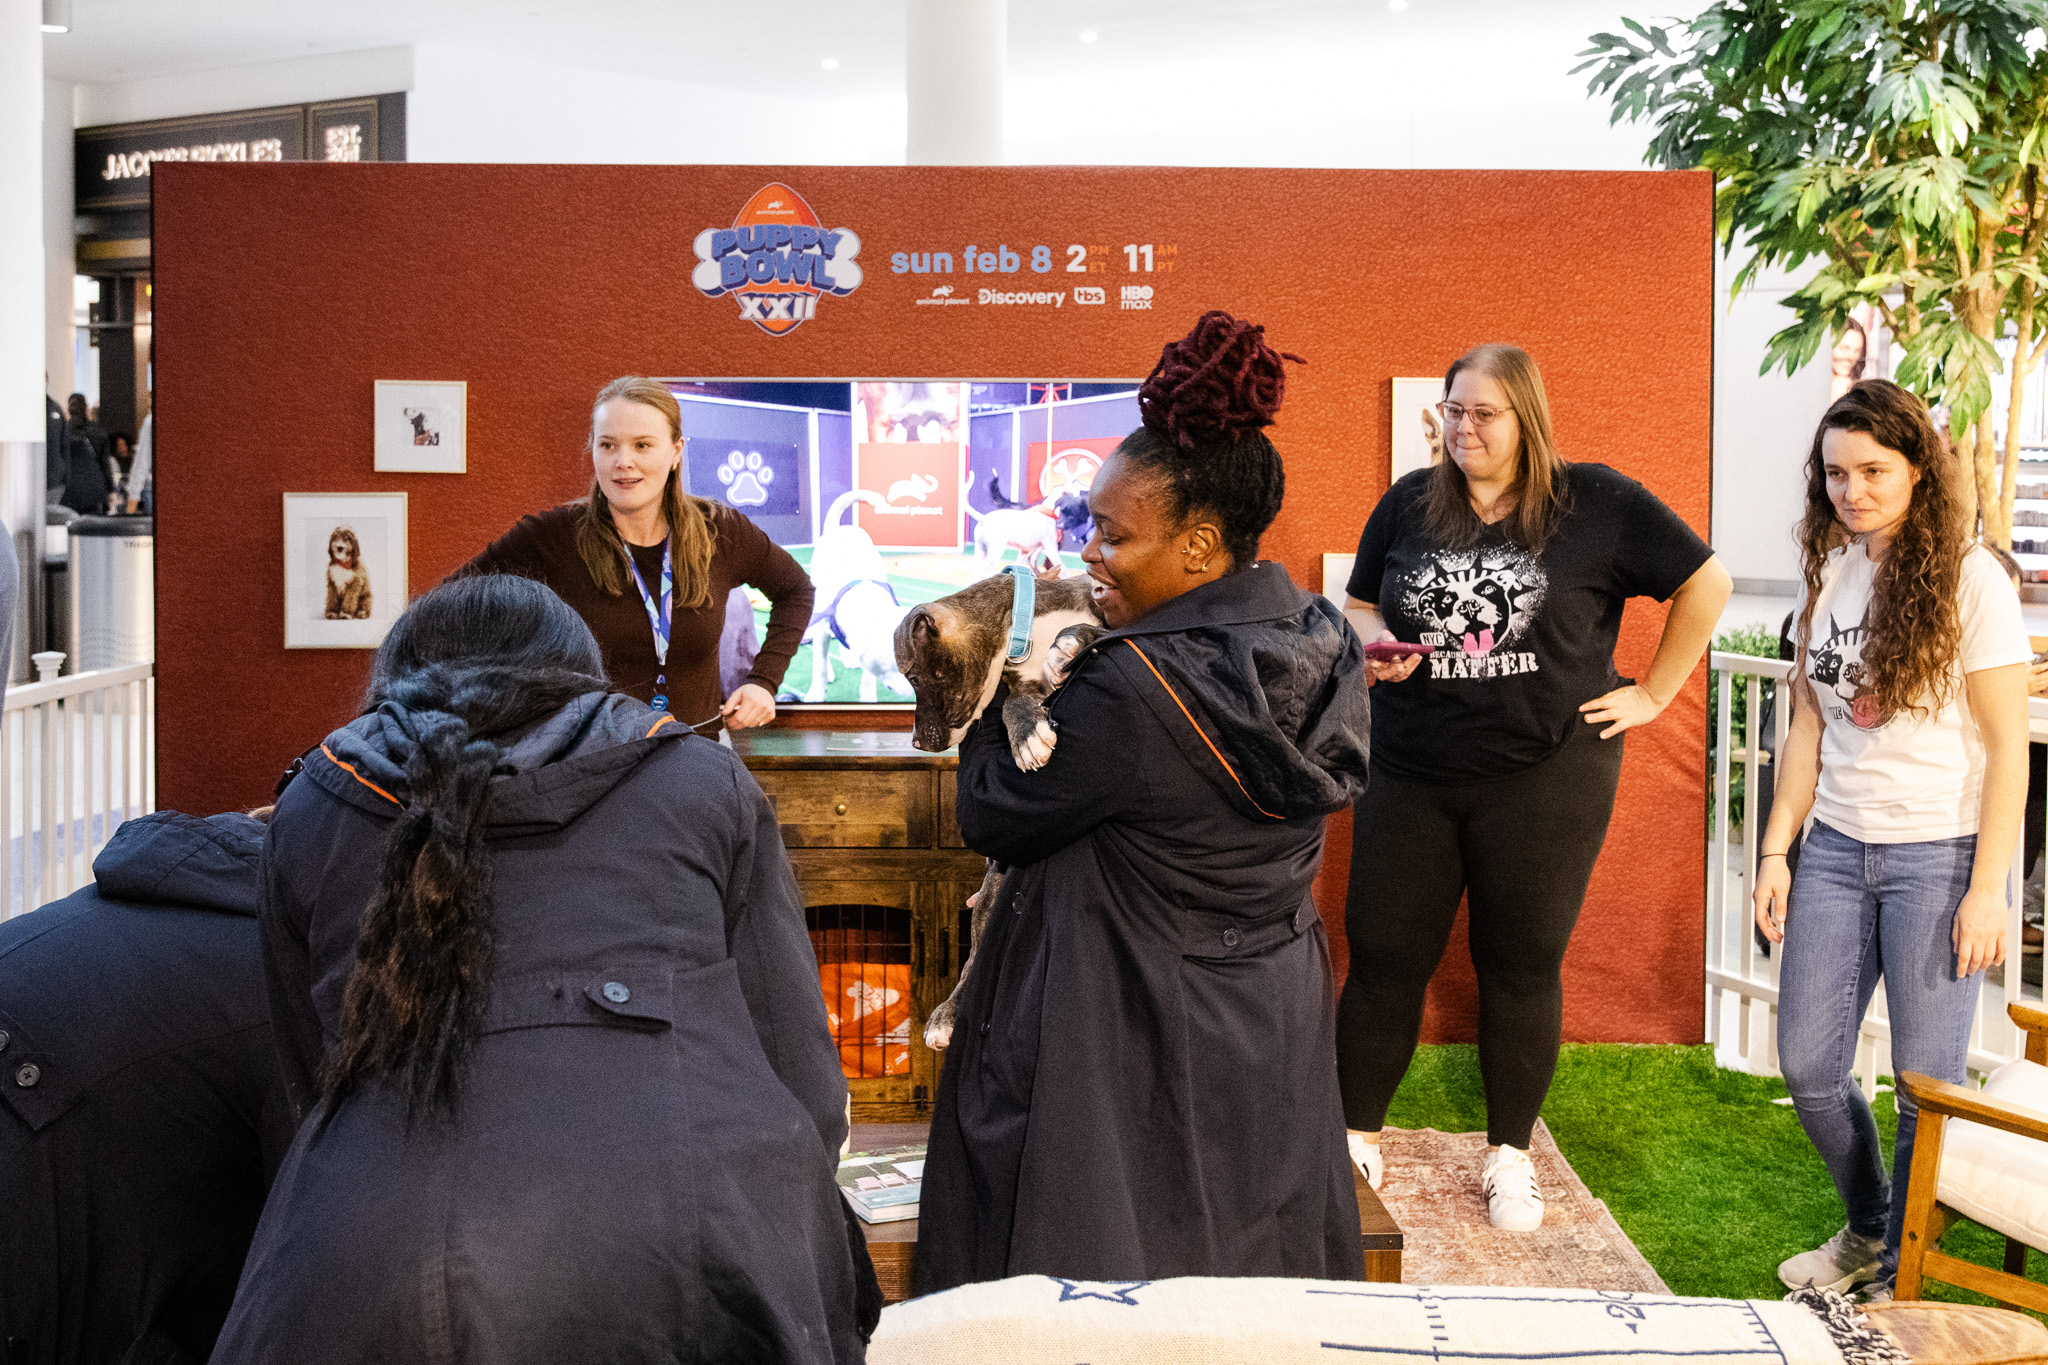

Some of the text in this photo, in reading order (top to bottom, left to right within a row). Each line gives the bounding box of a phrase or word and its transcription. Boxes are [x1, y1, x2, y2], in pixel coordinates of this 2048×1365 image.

[711, 224, 843, 261] PUPPY
[1089, 245, 1109, 255] PM
[1157, 245, 1178, 256] AM
[891, 244, 1154, 273] sun feb 8 2 11
[719, 250, 836, 290] BOWL
[1089, 261, 1106, 273] ET
[1157, 261, 1175, 272] PT
[978, 288, 1066, 308] Discovery
[1077, 291, 1102, 301] tbs
[1121, 285, 1154, 300] HBO
[739, 294, 816, 320] XXII
[945, 298, 970, 306] planet
[1121, 300, 1152, 310] max
[1422, 633, 1443, 645] NYC
[1429, 652, 1539, 679] MATTER
